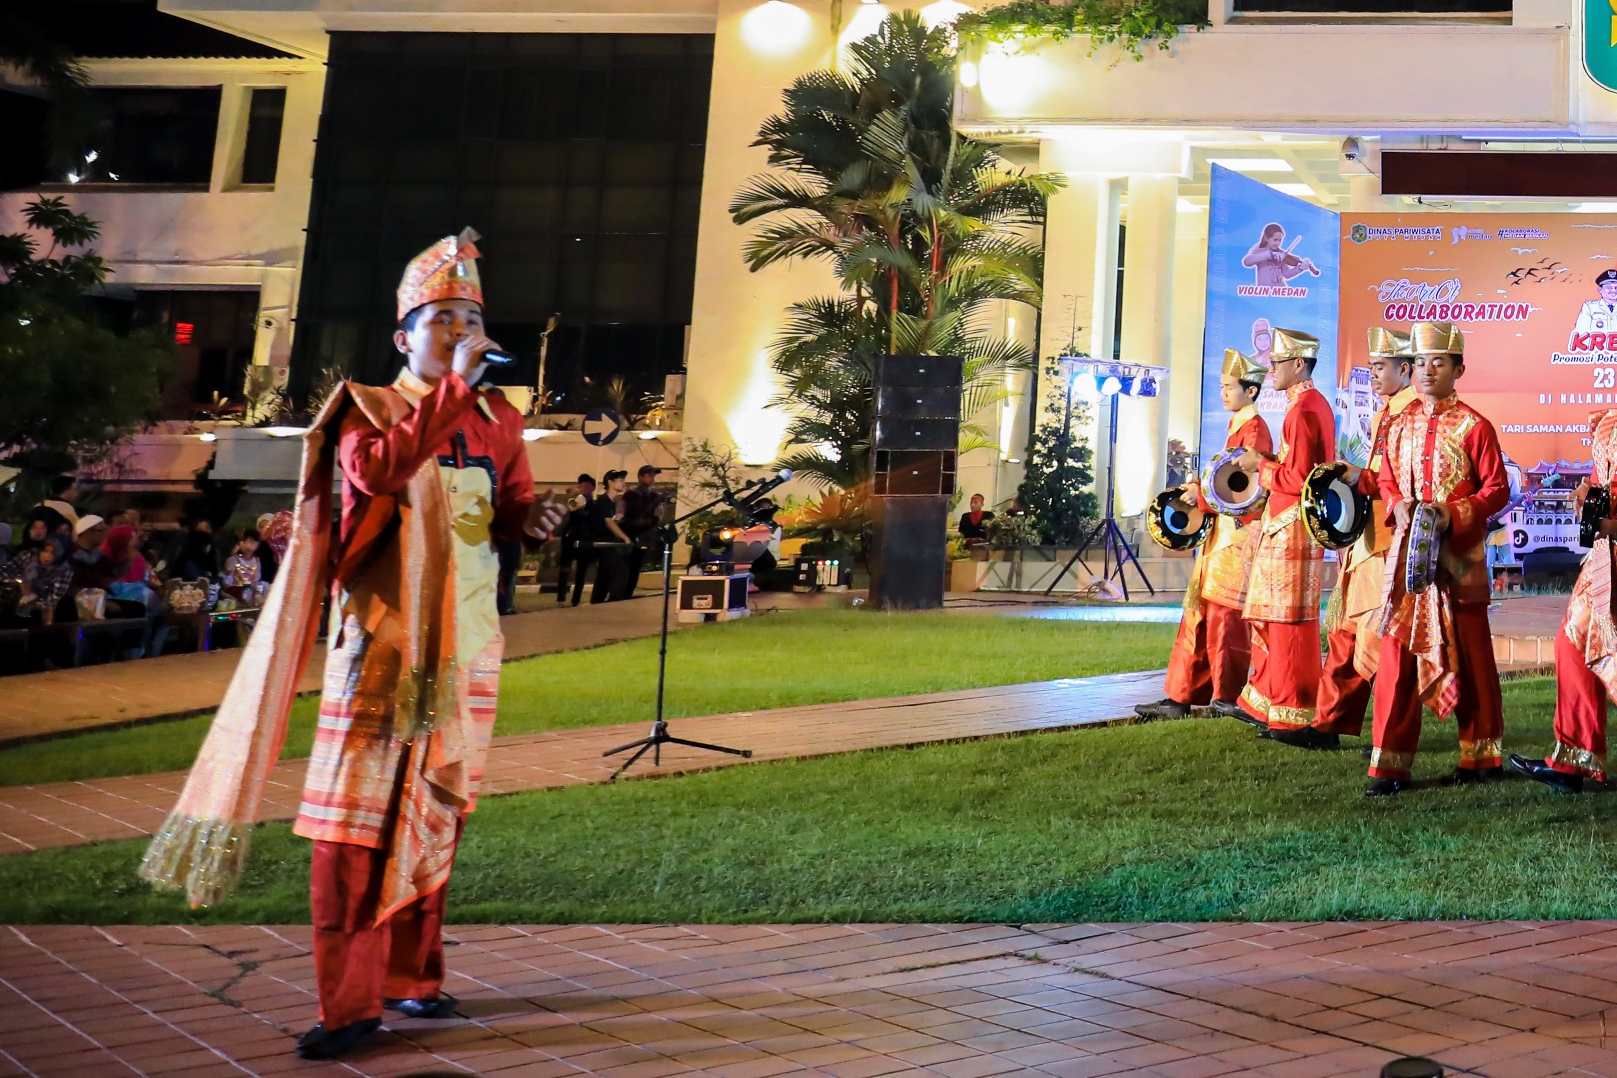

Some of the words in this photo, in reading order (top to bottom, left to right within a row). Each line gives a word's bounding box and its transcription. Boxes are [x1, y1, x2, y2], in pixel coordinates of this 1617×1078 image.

[1238, 286, 1270, 295] VIOLIN
[1272, 288, 1307, 296] MEDAN
[1385, 304, 1530, 320] COLLABORATION
[1553, 353, 1594, 362] Promosi
[1593, 368, 1615, 388] 23
[1540, 394, 1552, 404] DI
